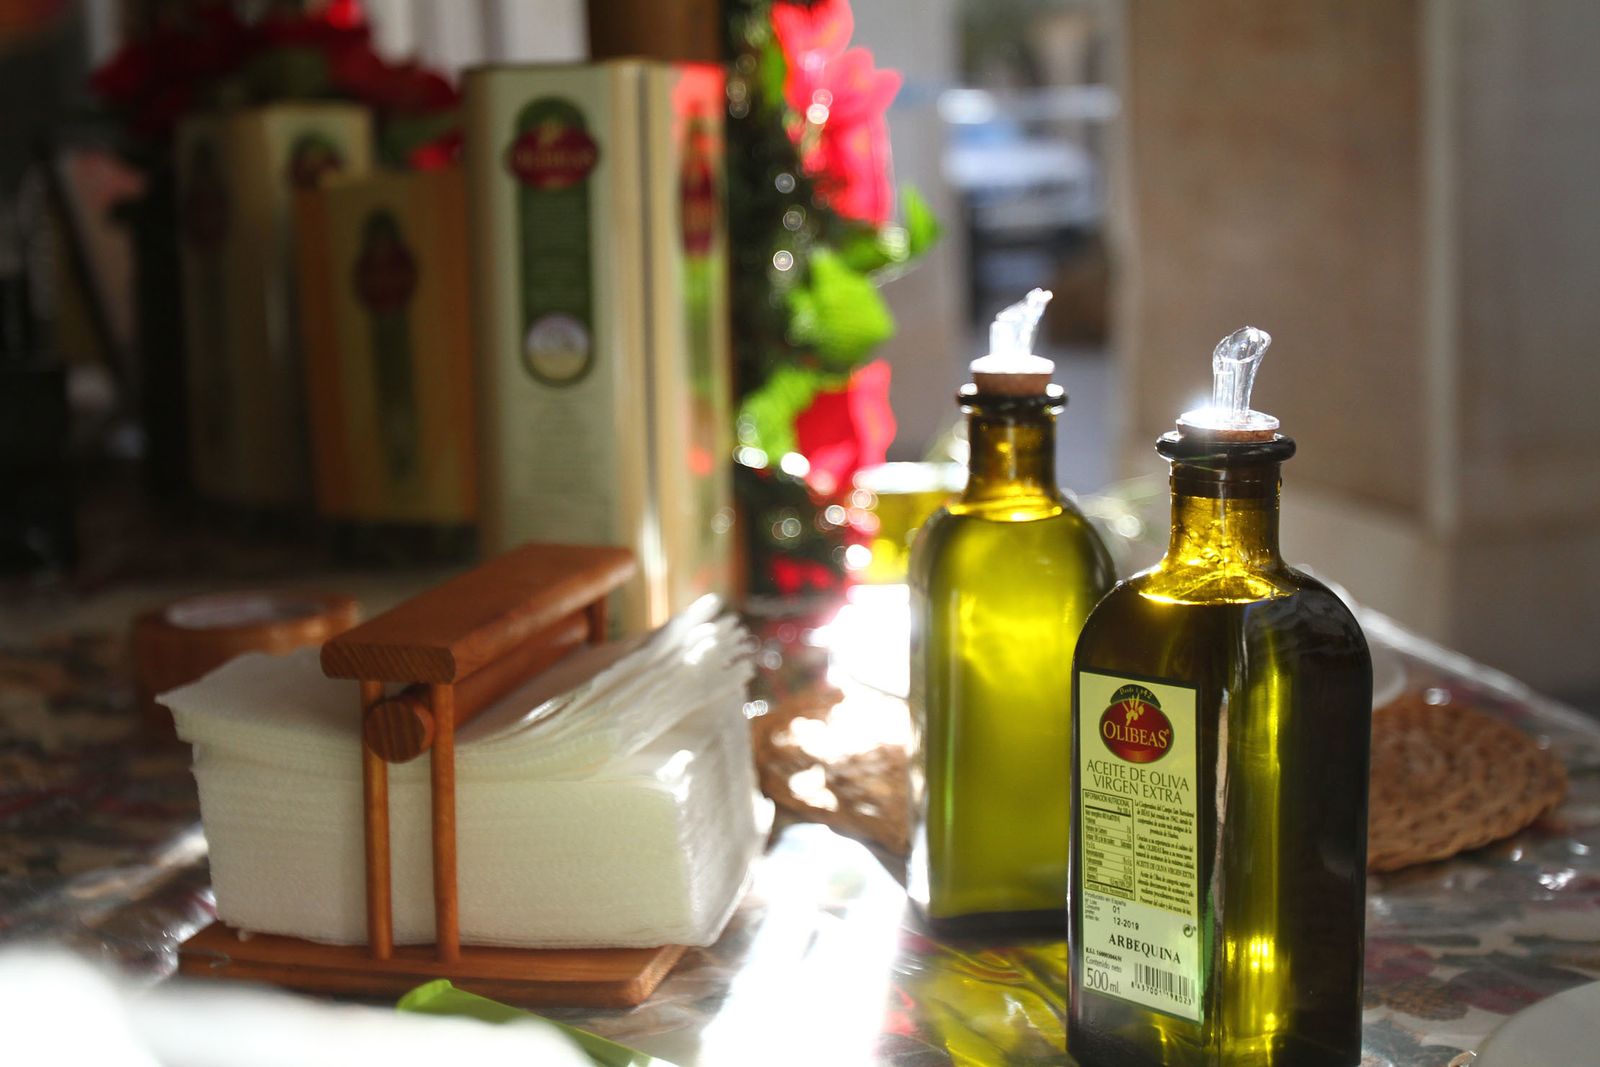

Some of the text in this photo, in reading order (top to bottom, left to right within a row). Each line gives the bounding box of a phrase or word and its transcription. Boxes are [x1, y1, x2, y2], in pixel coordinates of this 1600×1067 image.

[1103, 720, 1168, 749] OLIBEAS
[1086, 759, 1189, 792] ACEITE DE OLIVA
[1093, 774, 1182, 805] VIRGEN EXTRA
[1112, 916, 1140, 930] 12-2019
[1108, 933, 1181, 964] ARBEQUINA
[1086, 967, 1109, 991] 500
